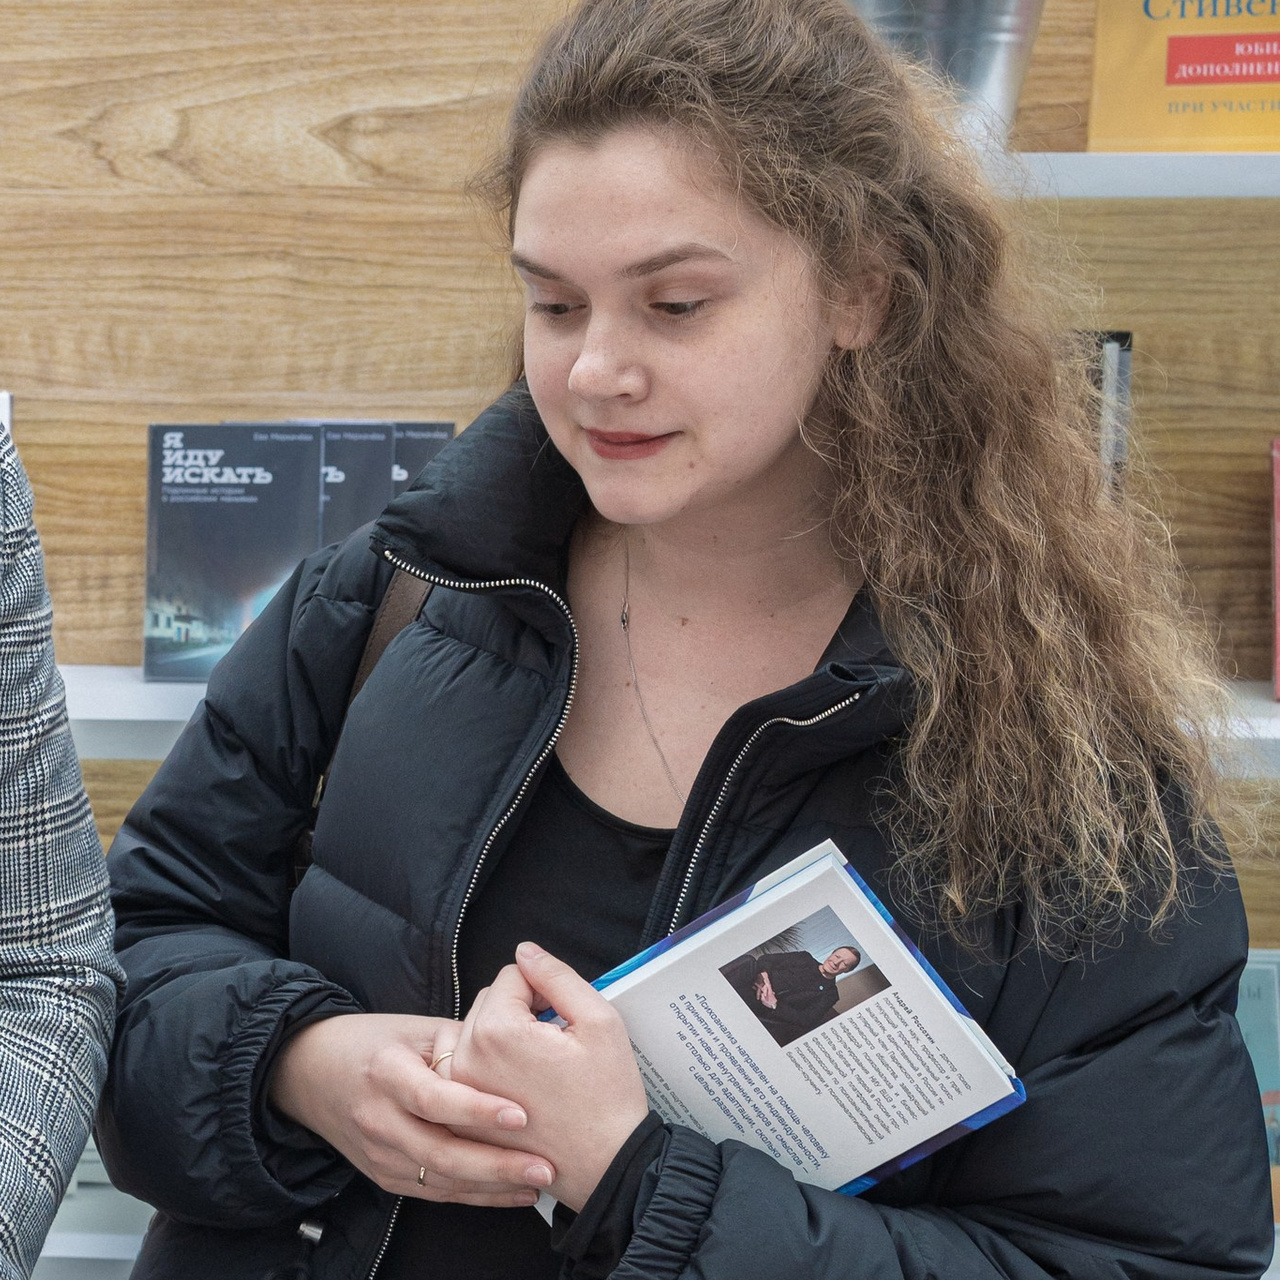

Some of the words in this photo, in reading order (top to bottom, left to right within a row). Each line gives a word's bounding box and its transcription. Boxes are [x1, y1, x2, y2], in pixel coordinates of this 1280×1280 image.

[162, 431, 184, 449] Я
[162, 449, 225, 467] ИДУ
[161, 466, 273, 484] ИСКАТЬ
[891, 991, 913, 1015] Андрей
[910, 1014, 935, 1045] Россохин
[938, 1052, 958, 1073] доктор
[920, 1043, 946, 1075] профессор
[669, 1002, 700, 1038] открытии
[697, 1037, 719, 1062] новых
[716, 1060, 753, 1104] внутренних
[750, 1103, 772, 1128] миров
[774, 1133, 804, 1166] смыслов
[683, 1000, 715, 1036] принятии
[717, 1042, 755, 1087] проявлении
[752, 1086, 767, 1101] его
[764, 1100, 821, 1170] индивидуальности,
[694, 993, 738, 1045] «Психоанализ
[735, 1044, 770, 1085] направлен
[767, 1084, 779, 1096] на
[775, 1095, 801, 1125] помощь
[801, 1124, 830, 1159] человеку
[920, 1075, 939, 1097] России
[675, 1030, 688, 1042] не
[684, 1041, 711, 1072] столько
[707, 1071, 724, 1087] для
[721, 1087, 756, 1129] адаптации,
[754, 1127, 782, 1159] сколько
[693, 1071, 716, 1096] целью
[711, 1096, 745, 1137] развития».
[873, 1096, 891, 1118] России
[878, 1088, 894, 1103] ВШЭ
